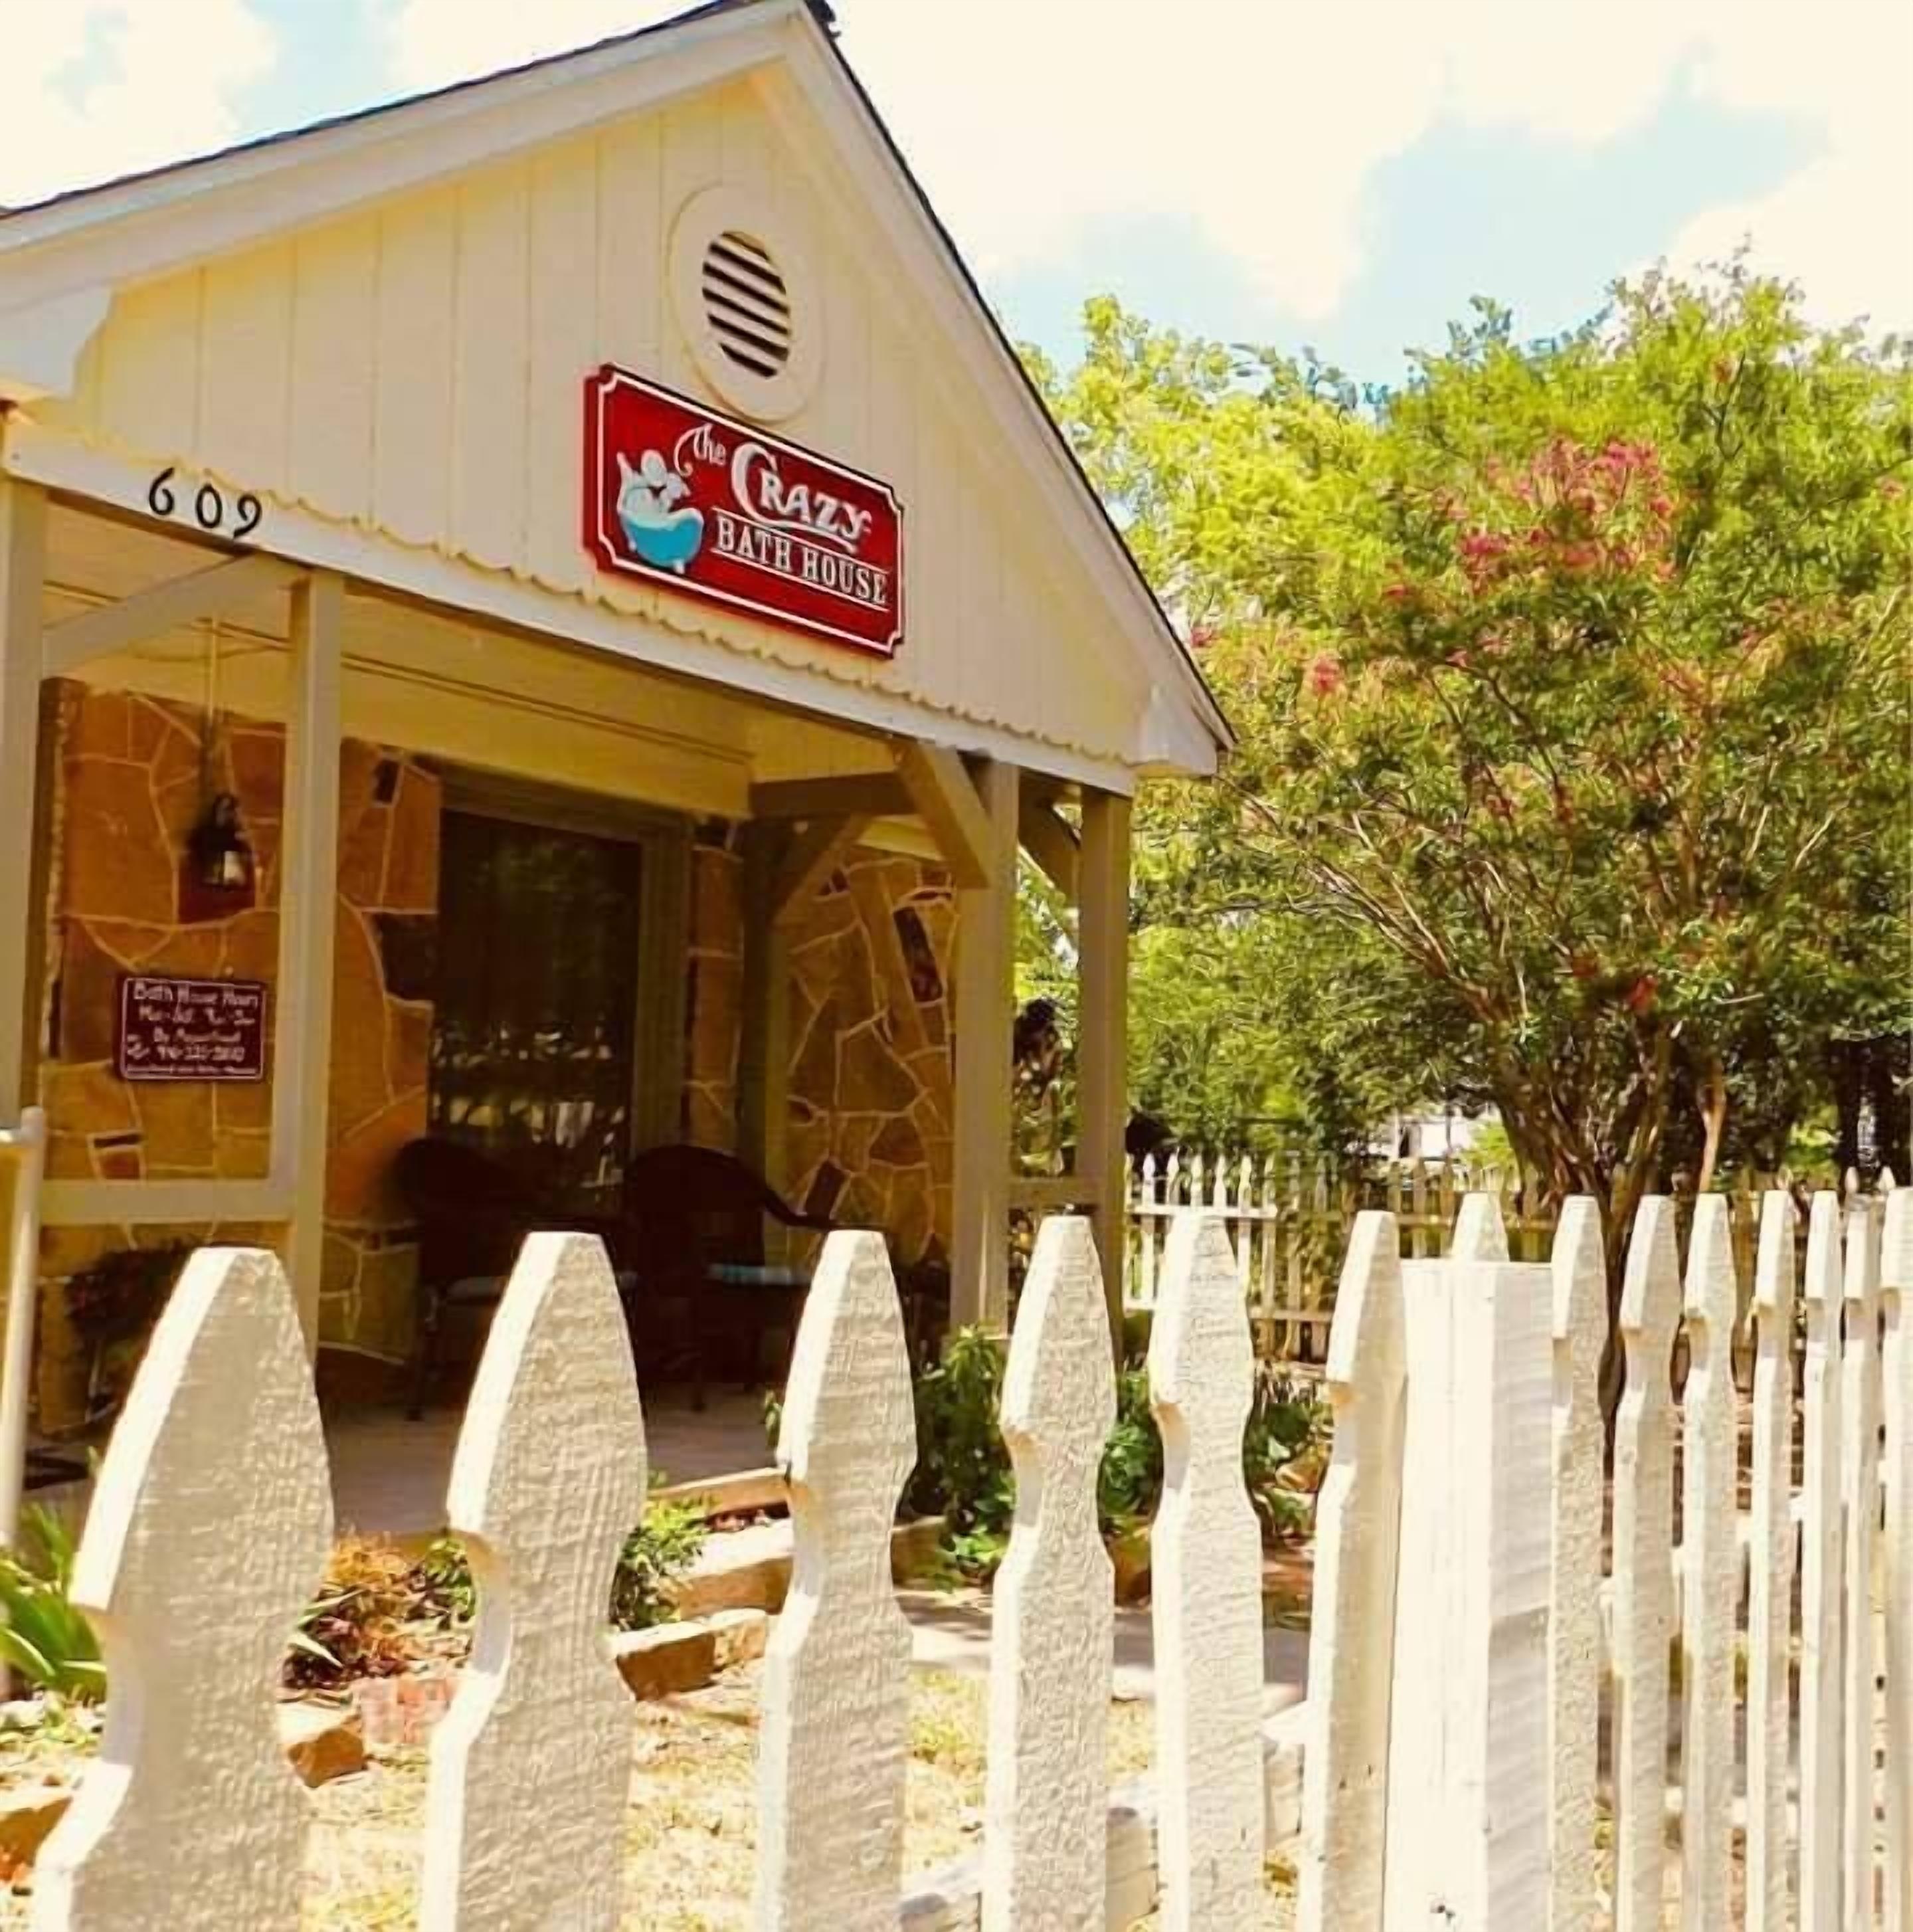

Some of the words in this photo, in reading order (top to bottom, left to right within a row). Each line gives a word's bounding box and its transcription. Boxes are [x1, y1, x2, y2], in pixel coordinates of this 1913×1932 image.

[149, 466, 263, 538] 609
[731, 442, 872, 553] CRAZY
[717, 512, 792, 573] BATH
[802, 545, 887, 605] HOUSE
